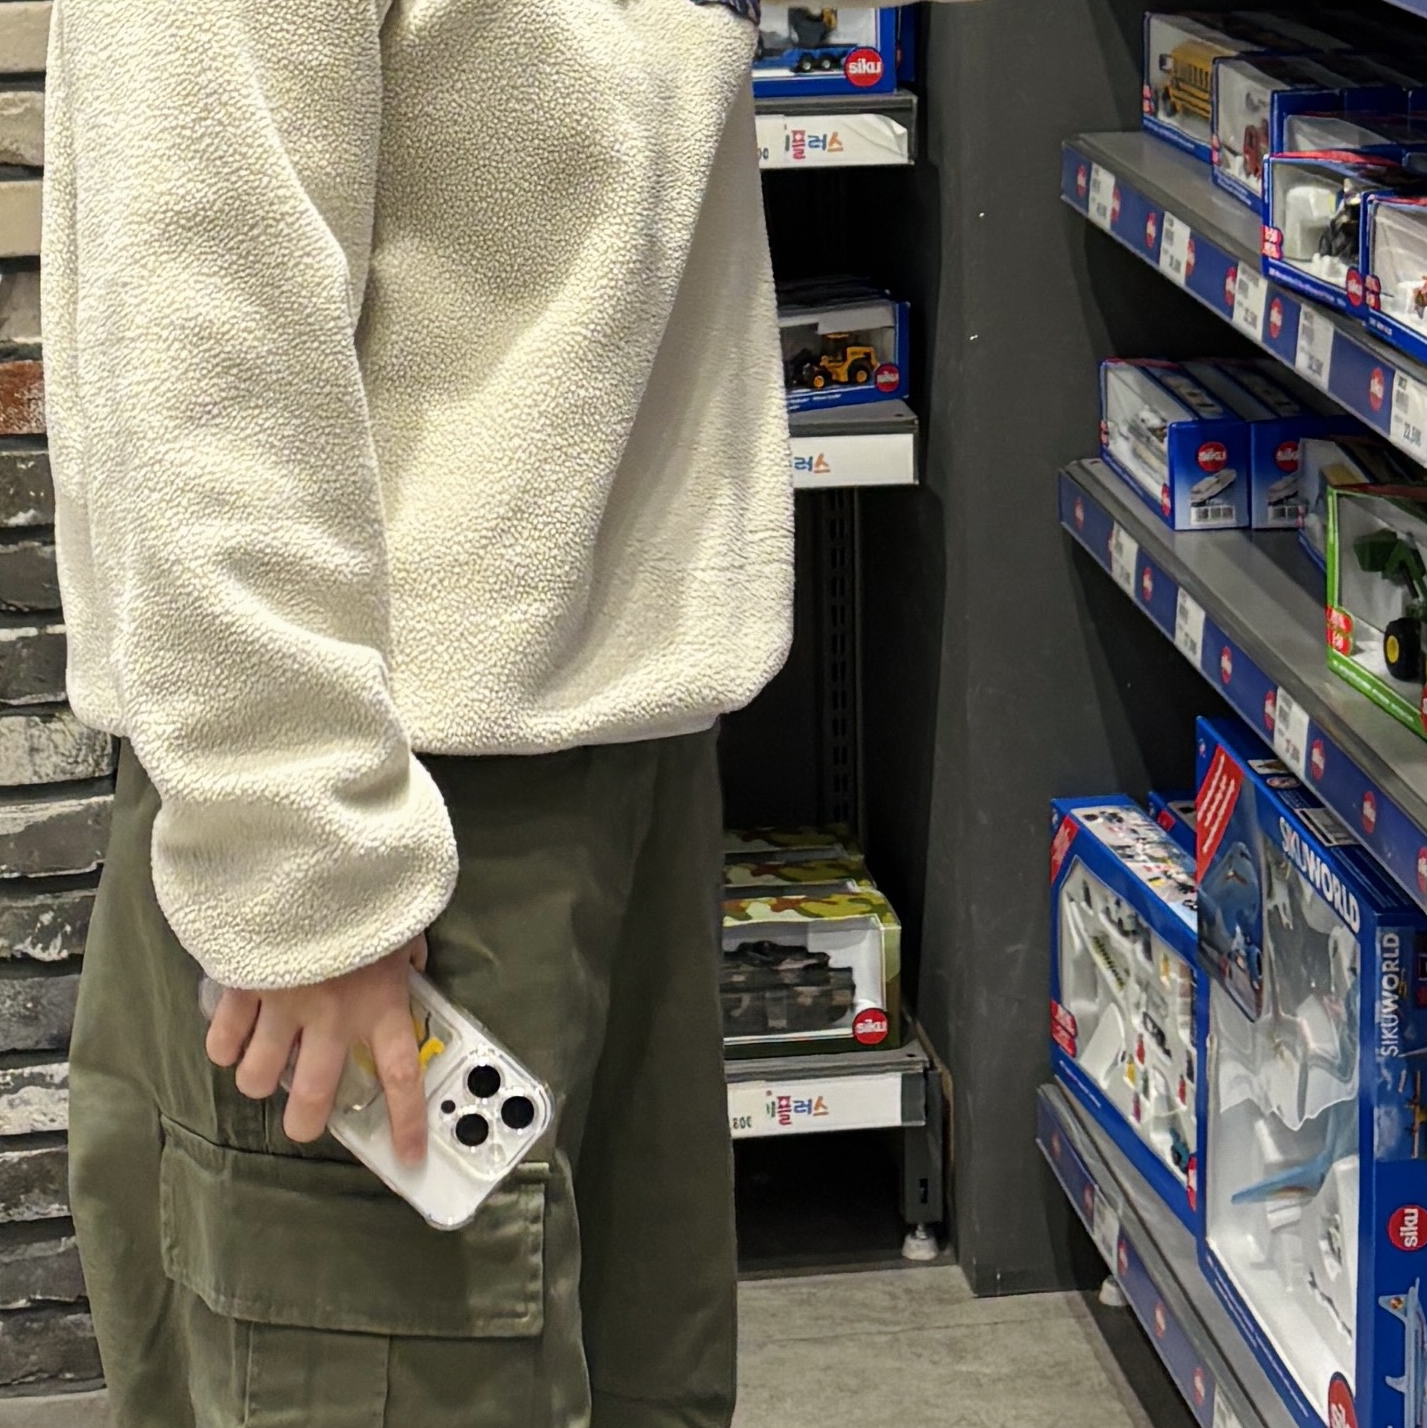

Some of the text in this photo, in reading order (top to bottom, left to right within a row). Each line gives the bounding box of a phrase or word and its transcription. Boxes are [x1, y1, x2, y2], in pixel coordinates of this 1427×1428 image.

[848, 58, 882, 74] siku
[1279, 816, 1361, 932] SIKUWORLD
[1381, 933, 1400, 1057] SIKUWORLD
[1404, 1208, 1420, 1247] siku
